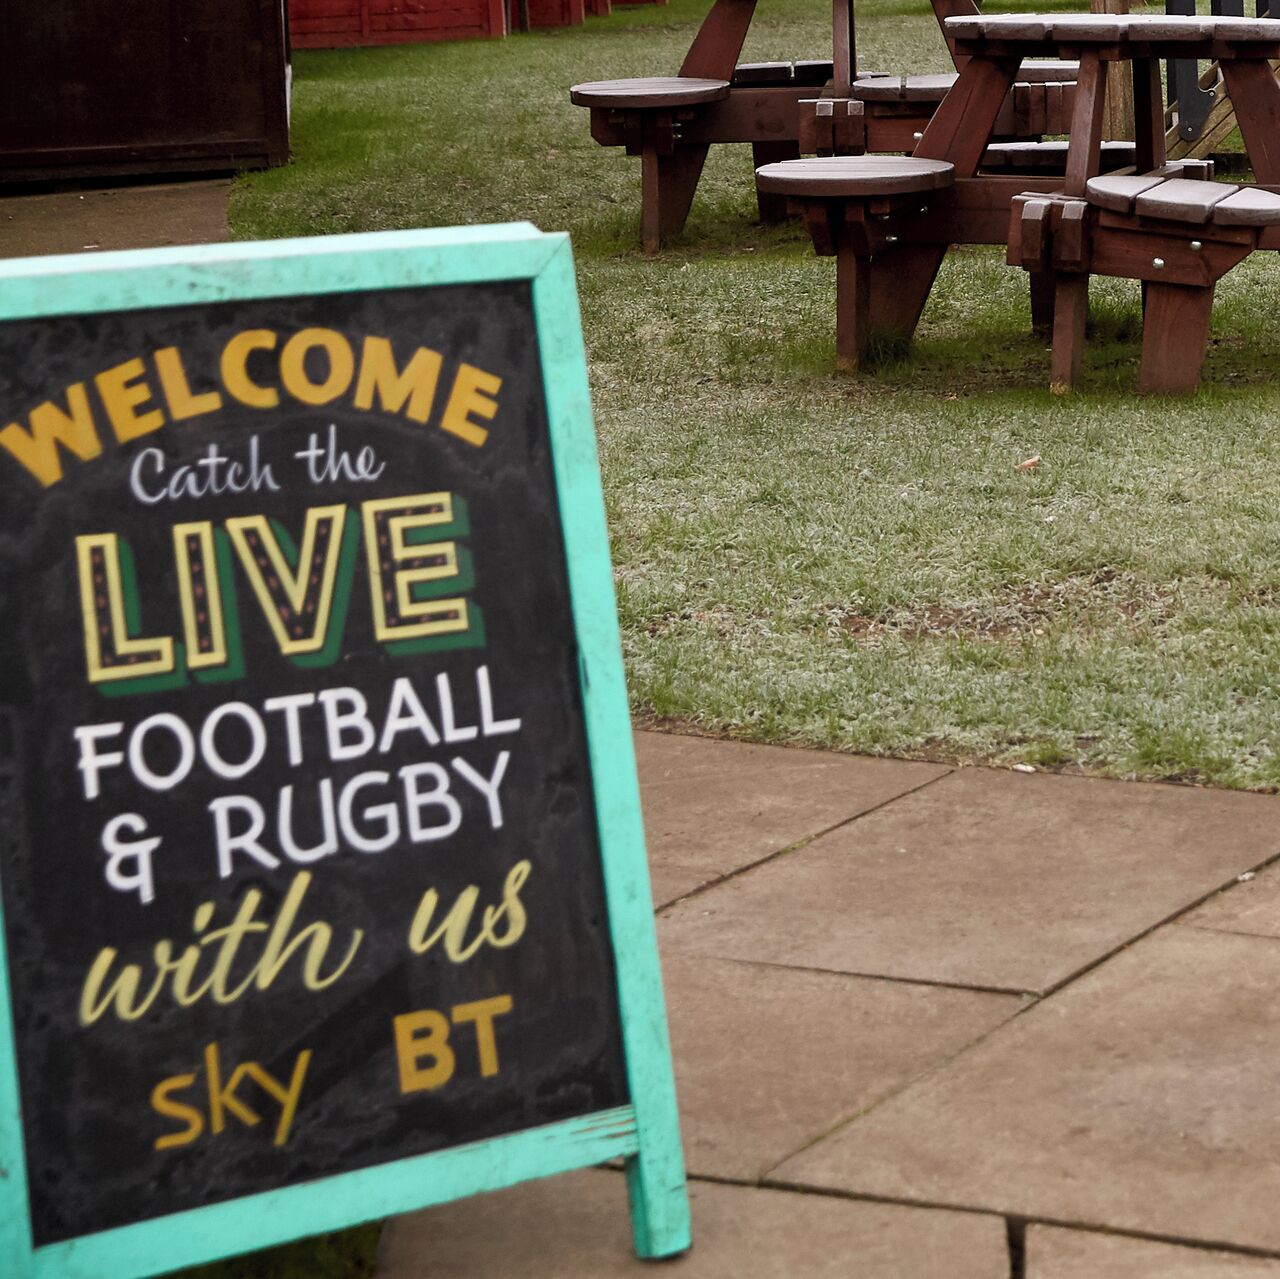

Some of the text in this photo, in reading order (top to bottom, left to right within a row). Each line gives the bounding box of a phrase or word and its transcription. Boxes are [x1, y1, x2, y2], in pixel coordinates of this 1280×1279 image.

[1, 327, 502, 487] WELCOME
[129, 423, 386, 506] Catch the
[75, 491, 483, 692] LIVE
[73, 664, 522, 801] FOOTBALL
[103, 751, 513, 905] & RUGBY
[78, 859, 534, 1028] with us
[393, 994, 514, 1094] BT
